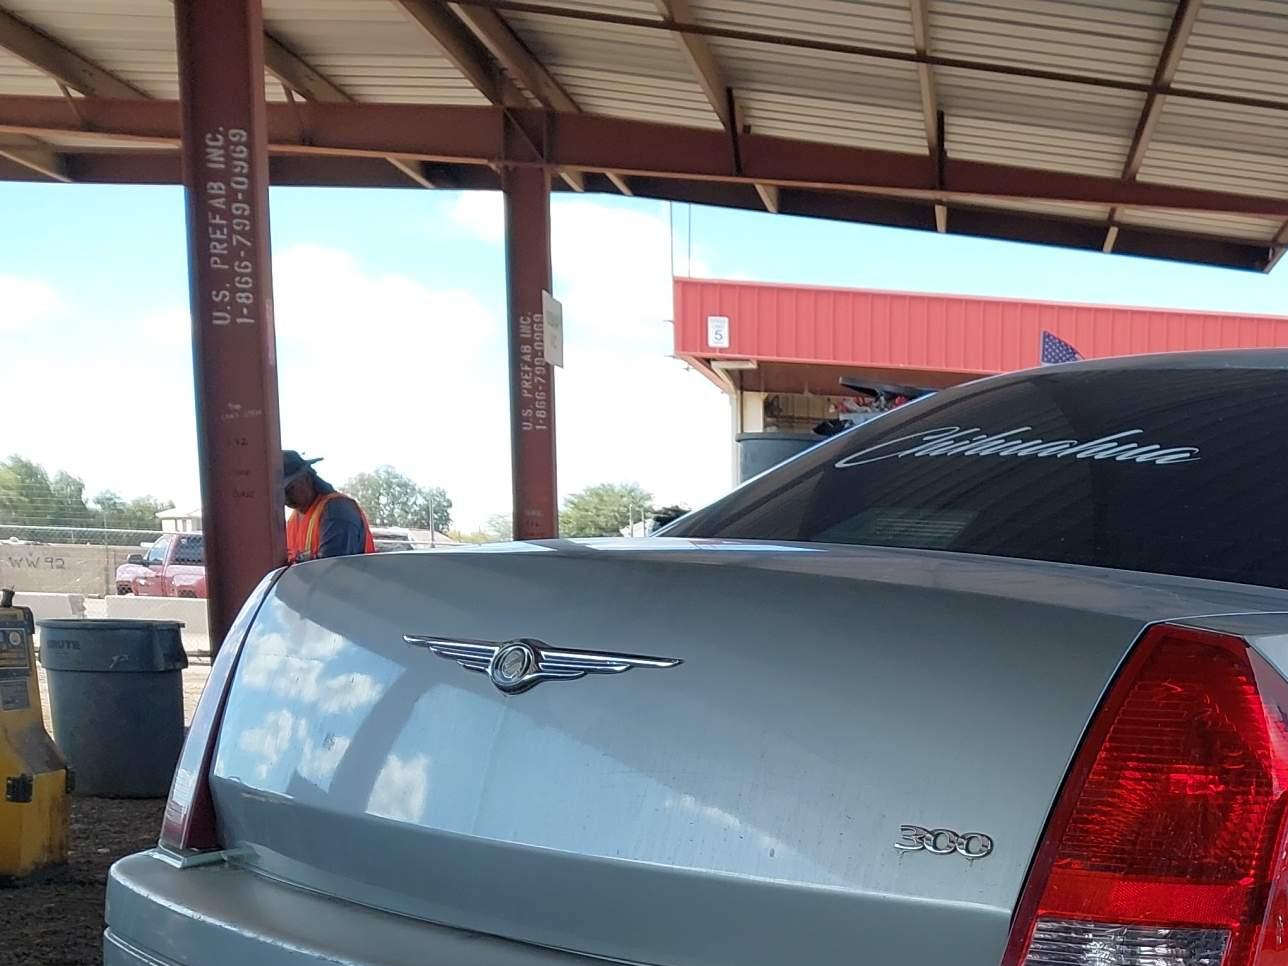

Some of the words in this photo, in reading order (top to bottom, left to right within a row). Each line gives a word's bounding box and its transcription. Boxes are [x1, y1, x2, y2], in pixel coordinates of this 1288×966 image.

[205, 126, 225, 169] INC.
[207, 181, 229, 269] PREFAB
[228, 128, 255, 324] 1-866-799-0969
[212, 283, 231, 325] U.S.
[519, 311, 532, 338] INC.
[714, 329, 724, 341] 5
[519, 345, 533, 398] PREFAB
[835, 426, 1201, 468] Chihuahua
[893, 824, 995, 858] 300
